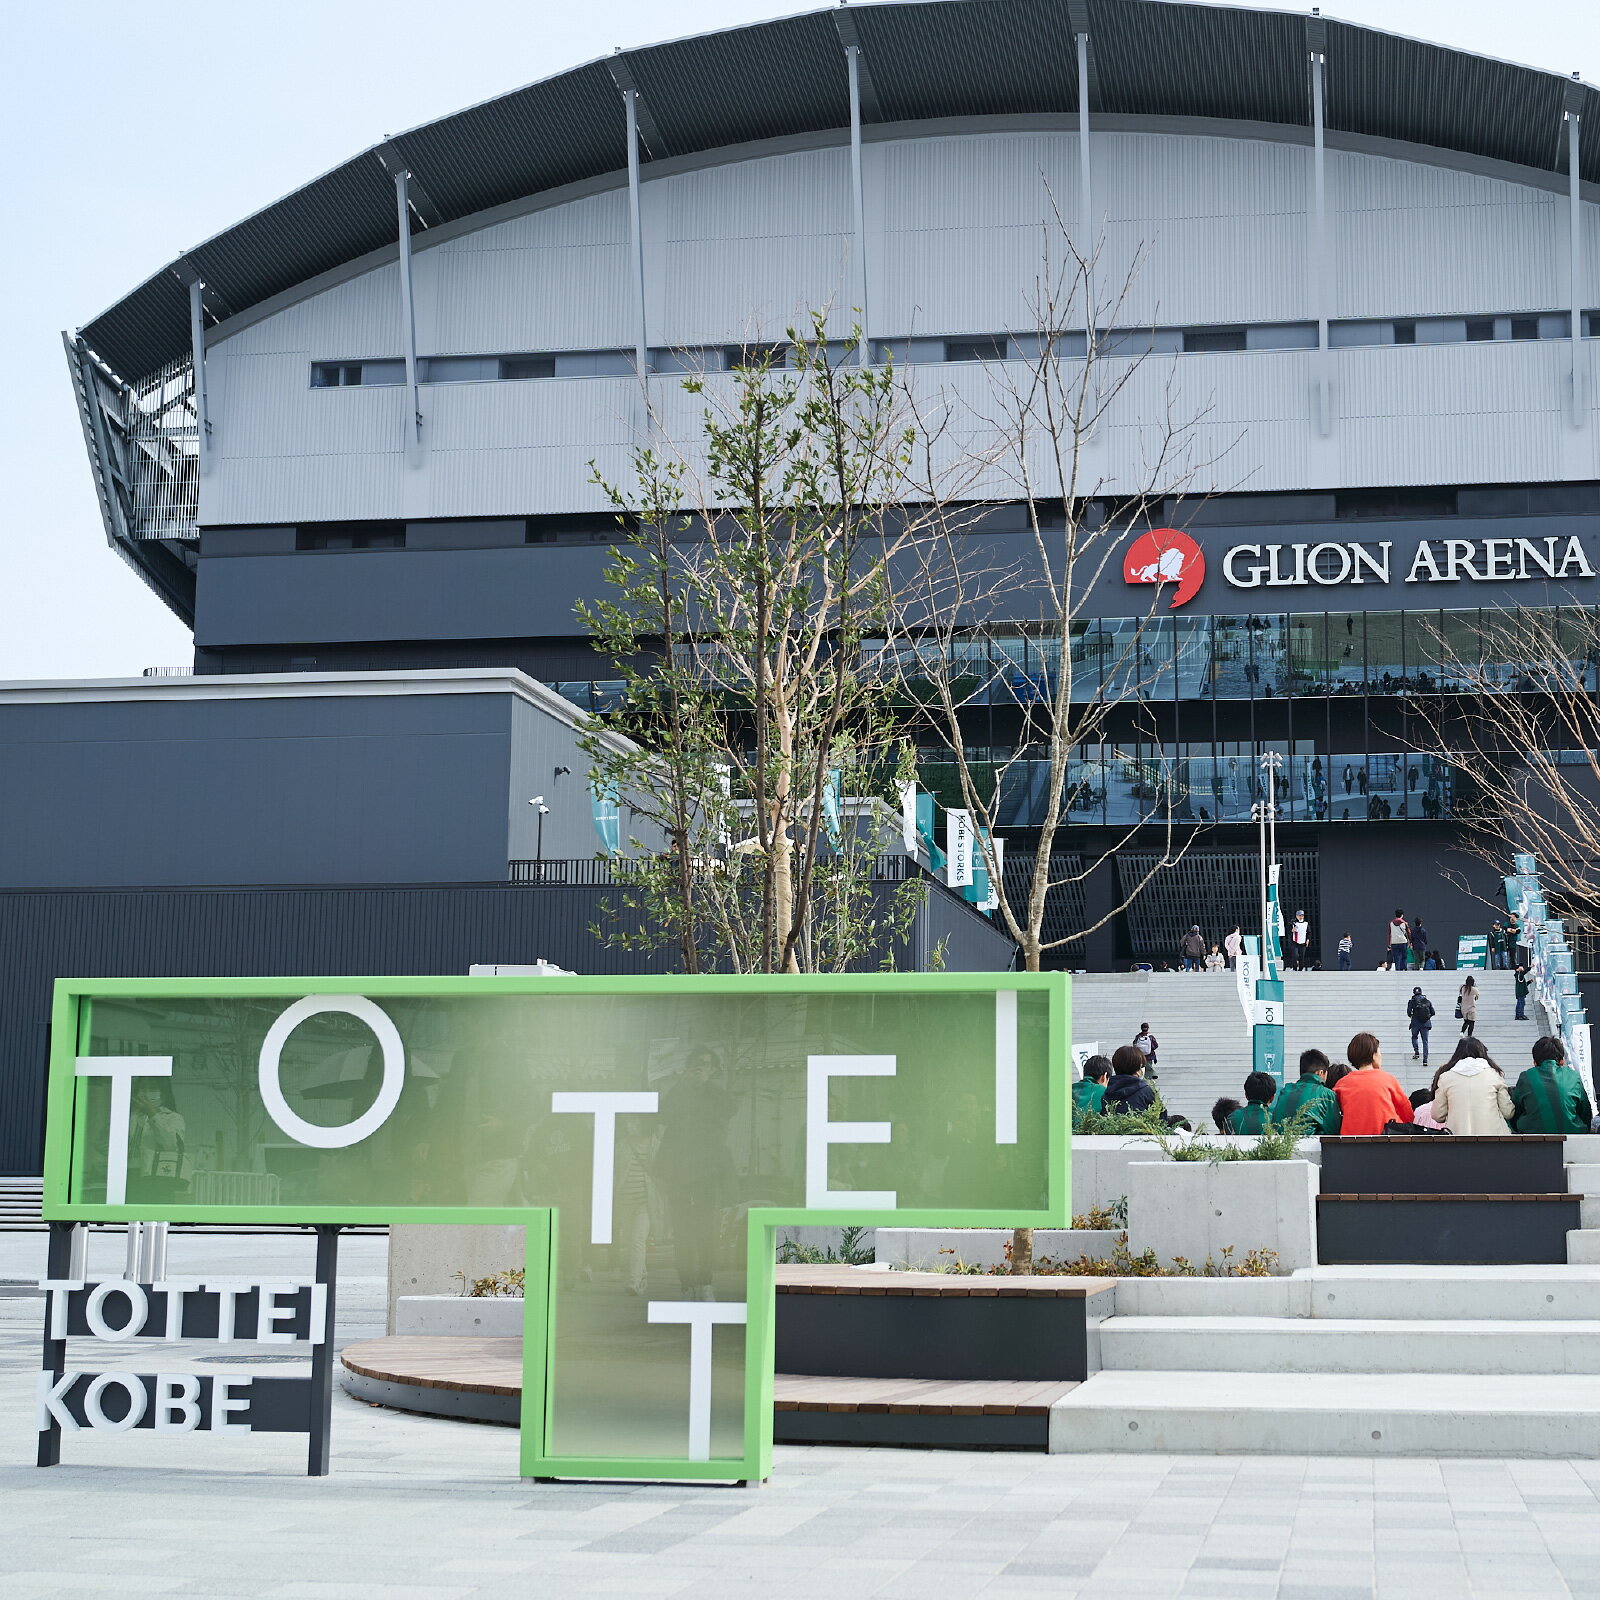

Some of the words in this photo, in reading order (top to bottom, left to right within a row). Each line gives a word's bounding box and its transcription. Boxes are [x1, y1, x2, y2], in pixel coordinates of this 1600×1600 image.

[1222, 541, 1393, 588] GLION
[1405, 535, 1596, 583] ARENA
[958, 815, 966, 840] KOBE
[957, 842, 965, 881] STORKS
[38, 1279, 328, 1345] TOTTEI
[36, 1369, 253, 1436] KOBE
